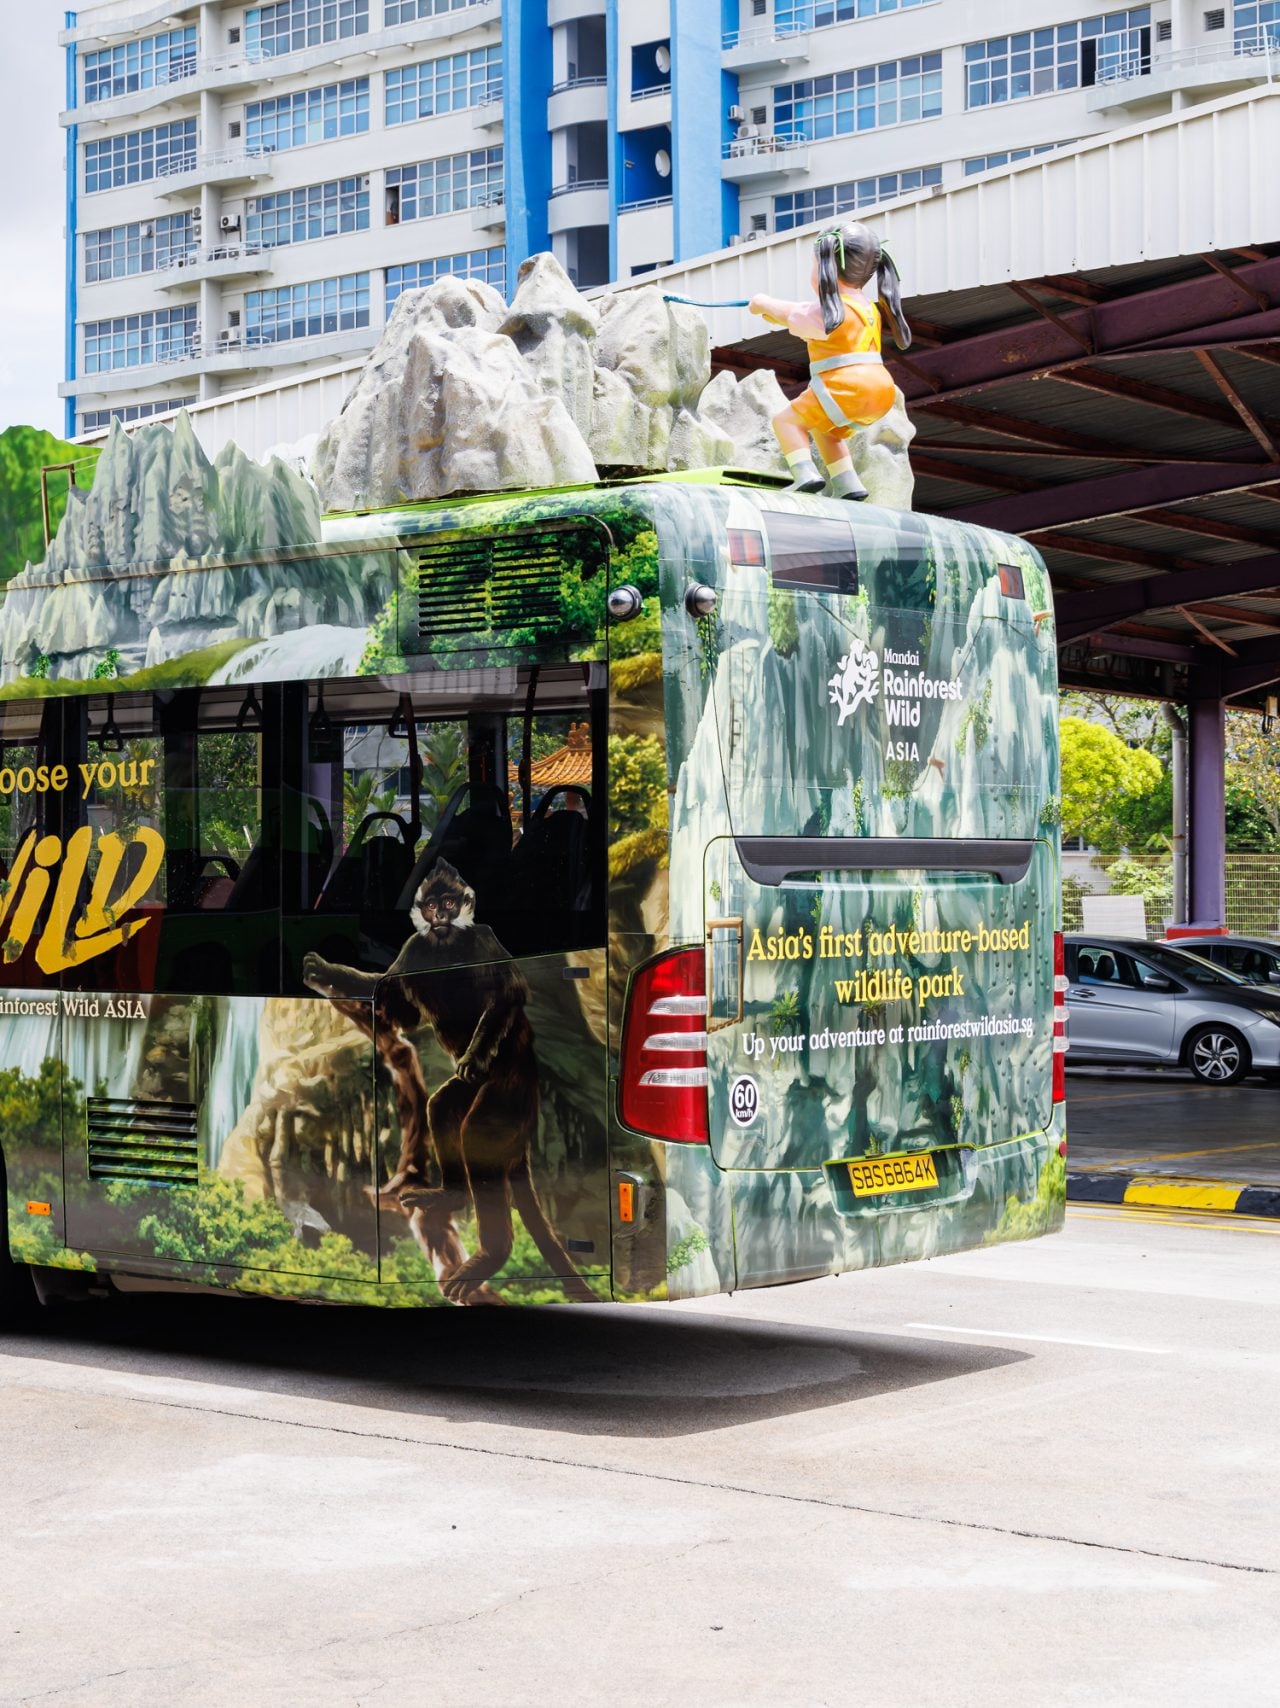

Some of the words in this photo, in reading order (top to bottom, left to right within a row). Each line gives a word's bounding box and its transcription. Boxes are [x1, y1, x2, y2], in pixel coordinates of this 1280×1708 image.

[883, 648, 920, 666] Mandai
[883, 669, 963, 701] Rainforest
[884, 699, 920, 727] Wild
[885, 741, 920, 762] ASIA
[78, 758, 156, 800] your
[747, 926, 813, 961] Asia's
[819, 925, 863, 958] first
[870, 920, 1030, 957] adventure-based
[834, 968, 913, 1004] wildlife
[918, 966, 964, 1008] park
[62, 998, 99, 1017] Wild
[104, 999, 147, 1019] ASIA
[742, 1032, 765, 1060] Up
[769, 1031, 805, 1059] your
[809, 1026, 885, 1050] adventure
[888, 1026, 904, 1044] at
[907, 1014, 1034, 1042] rainforestwildasia.sg
[734, 1084, 755, 1109] 60
[735, 1108, 754, 1119] km/h
[852, 1163, 935, 1190] SBS6864K
